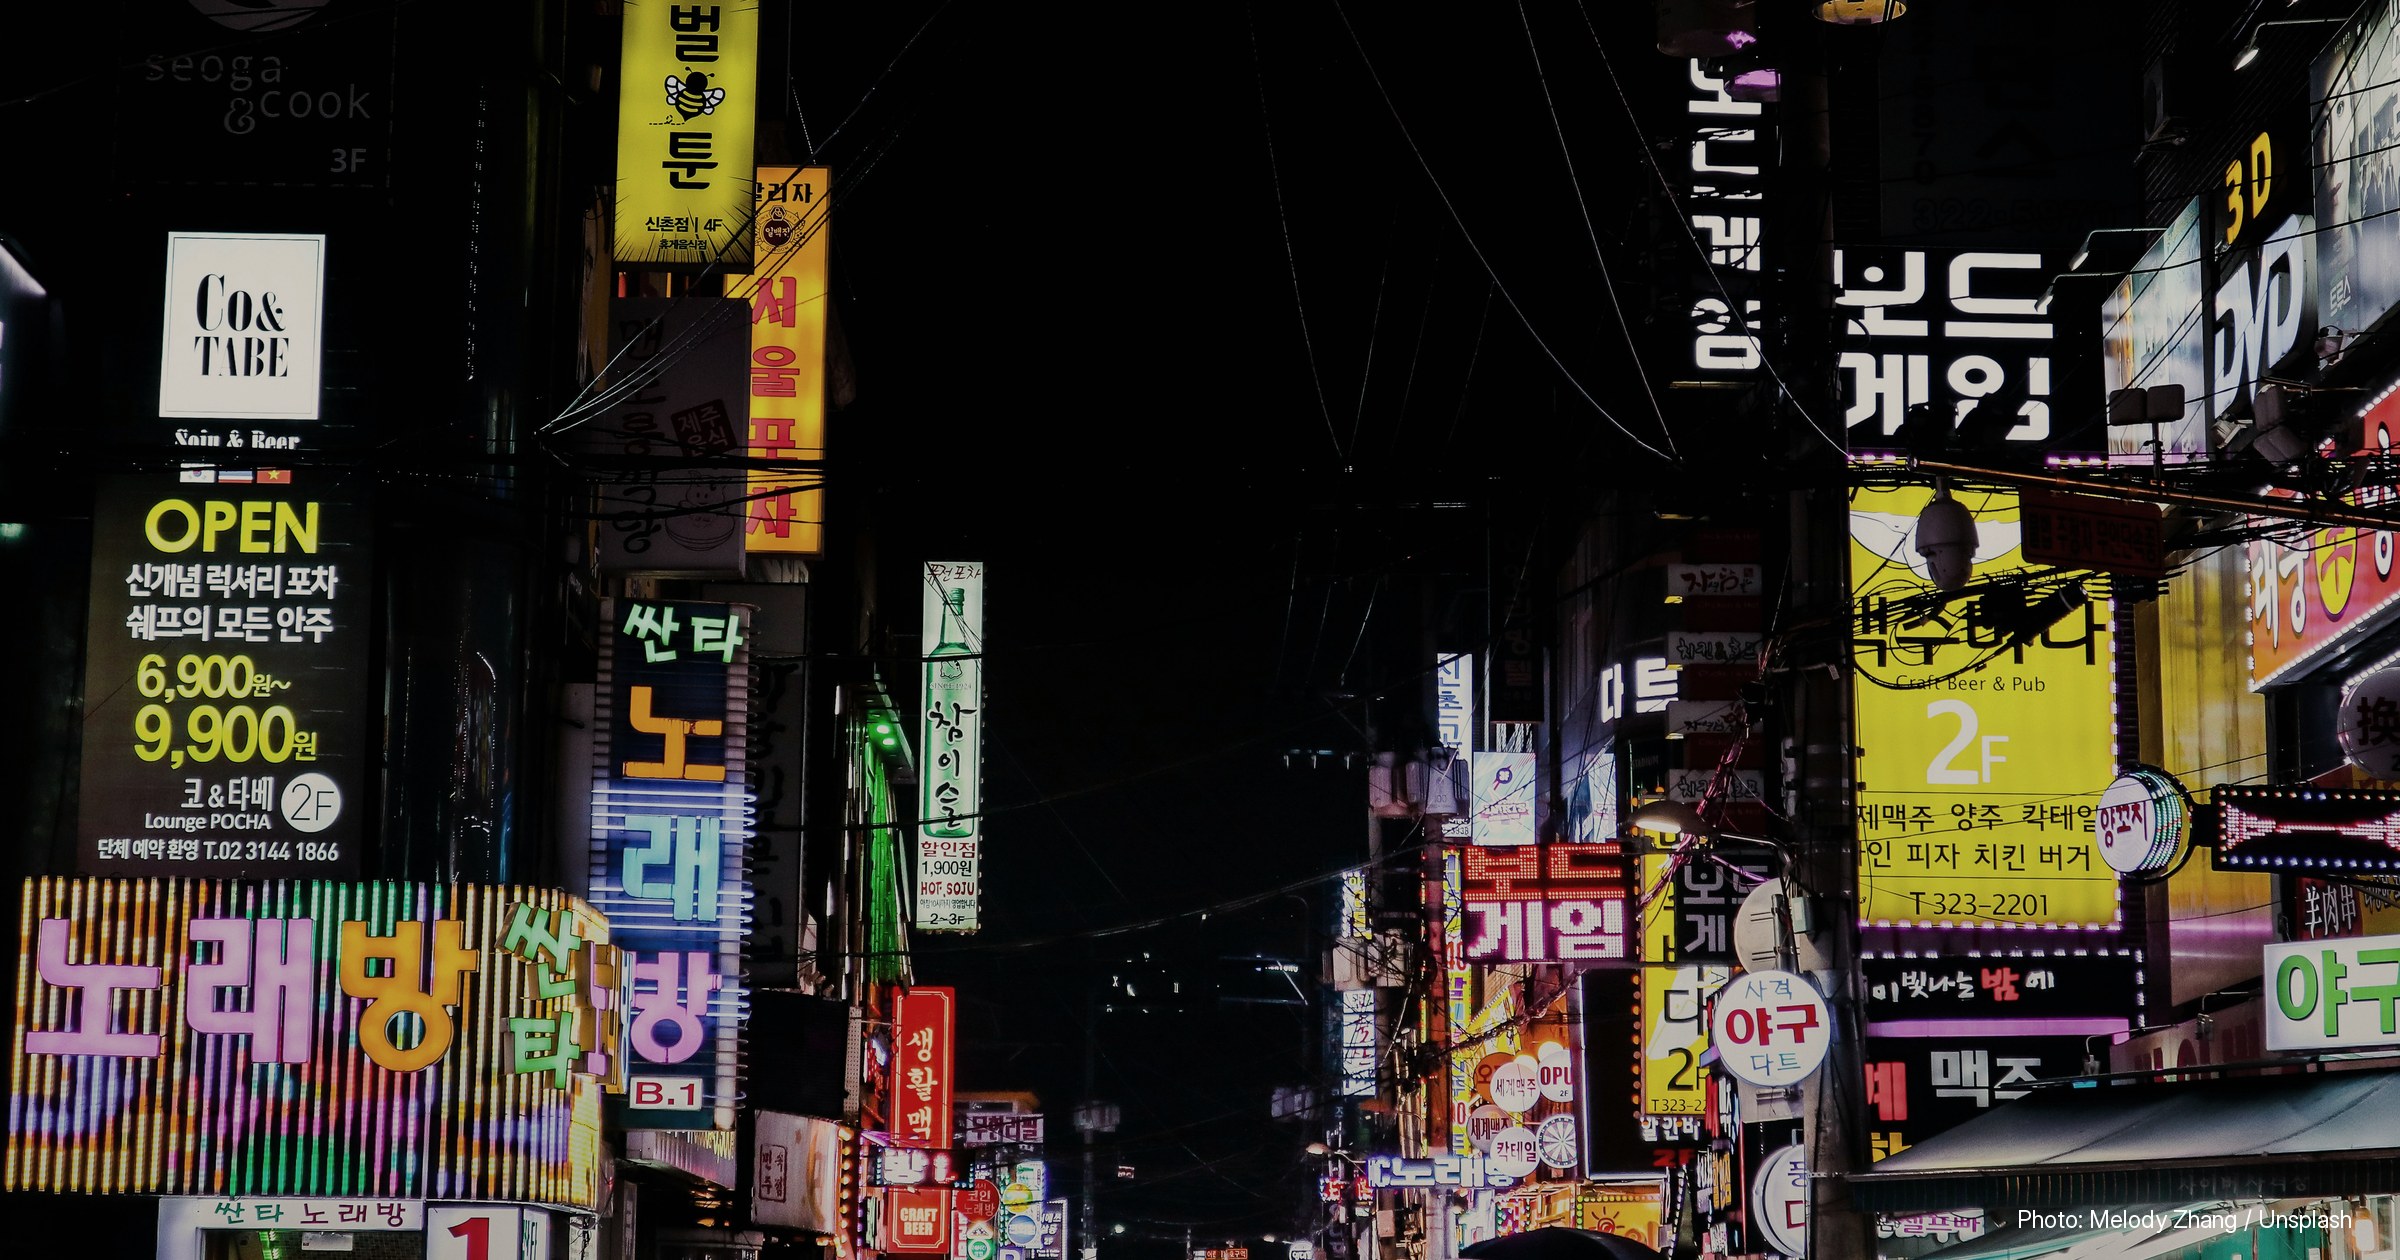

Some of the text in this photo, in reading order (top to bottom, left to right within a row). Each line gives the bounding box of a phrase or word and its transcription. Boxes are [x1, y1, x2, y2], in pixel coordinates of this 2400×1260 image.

[144, 54, 281, 93] seoga
[259, 82, 371, 120] cook
[330, 147, 367, 174] 3F
[2224, 131, 2273, 247] 3D
[646, 216, 723, 233] 신촌점 4F
[195, 272, 287, 333] Co&
[1834, 249, 2054, 340] 보드
[2212, 213, 2306, 420] DVD
[194, 336, 290, 379] TABE
[746, 276, 800, 539] 서울포차
[1836, 351, 2051, 442] 게임
[144, 498, 320, 554] OPEN
[125, 562, 339, 600] 신개념 럭셔리 포차
[125, 603, 335, 643] 쉐프의 모든 안주
[622, 603, 744, 664] 싼타
[1600, 655, 1680, 725] 다트
[1896, 674, 2047, 693] Craft Beer & Pub
[133, 703, 318, 770] 9,900원
[1926, 699, 2011, 787] 2F
[928, 700, 977, 829] 참이슬
[289, 782, 335, 822] 2F
[1951, 802, 2005, 832] 양주
[2022, 804, 2098, 834] 칵테일
[144, 812, 273, 834] Lounge POCHA
[97, 838, 340, 863] 단체 예약 환영 T.02 3144 1866
[920, 841, 977, 859] 할인점
[921, 860, 974, 878] 1,900원
[1906, 843, 1961, 870] 피자
[1974, 844, 2026, 872] 치킨
[2039, 844, 2091, 872] 버거
[622, 684, 729, 1065] 노래방
[1466, 843, 1627, 901] 보드
[1909, 891, 2050, 917] T 323-2201
[2303, 883, 2358, 940] 羊肉串
[1467, 901, 1626, 961] 게임
[26, 916, 480, 1073] 노래방
[502, 901, 583, 1090] 싼타
[1744, 977, 1794, 1002] 사격
[2275, 948, 2400, 1038] 야구
[1724, 1003, 1820, 1046] 야구
[1749, 1052, 1803, 1077] 다트
[634, 1081, 696, 1106] B.1
[1495, 1078, 1537, 1098] 세계맥주
[1559, 1090, 1569, 1098] 2F
[1496, 1140, 1538, 1163] 칵테일
[214, 1201, 407, 1228] 싼타 노래방
[900, 1207, 939, 1223] CRAFT
[963, 1203, 996, 1216] 노래방
[966, 1189, 991, 1202] 코인
[903, 1221, 934, 1236] BEER
